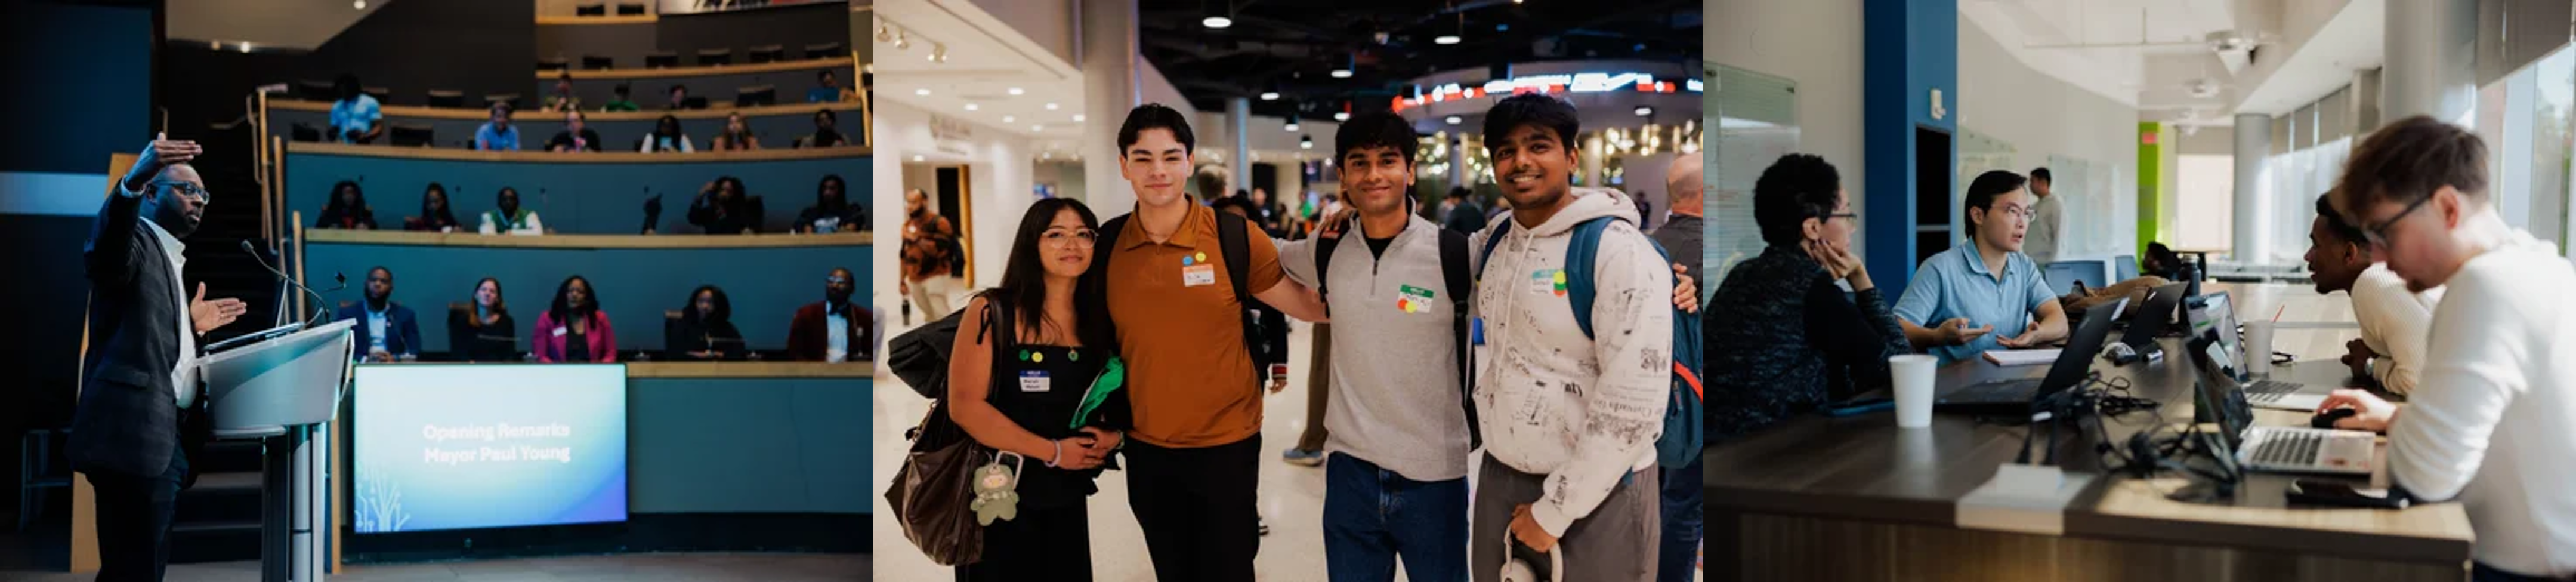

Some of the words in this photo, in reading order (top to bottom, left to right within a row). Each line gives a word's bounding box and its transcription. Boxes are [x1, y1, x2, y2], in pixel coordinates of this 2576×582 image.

[422, 423, 495, 443] Opening
[498, 421, 570, 437] Remarks
[425, 446, 477, 466] Mayor
[480, 446, 517, 462] Paul
[520, 445, 571, 463] Young
